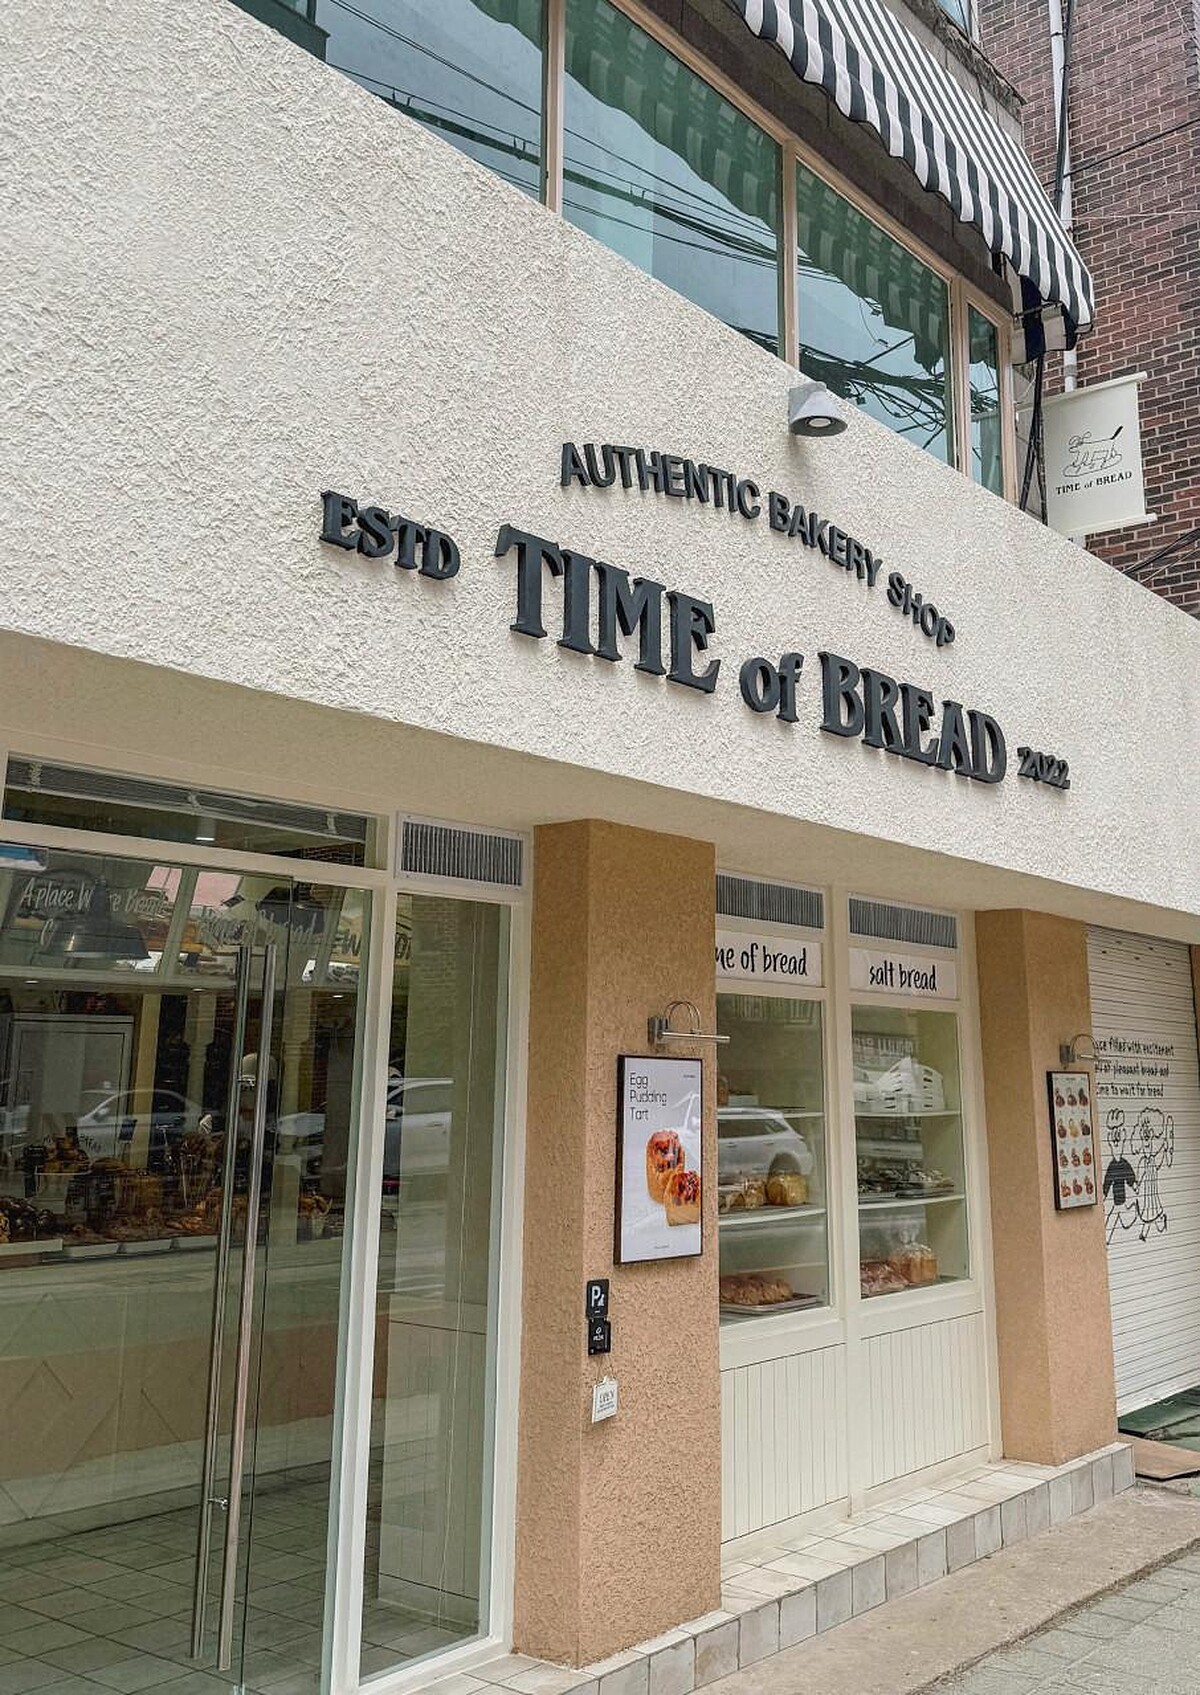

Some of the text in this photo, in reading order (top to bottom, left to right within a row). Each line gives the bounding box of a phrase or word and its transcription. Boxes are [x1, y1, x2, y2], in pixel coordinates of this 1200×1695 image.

[1056, 471, 1132, 495] TIME of BREAD
[561, 442, 955, 647] AUTHENTIC BAKERY SHOP
[319, 489, 1070, 789] ESTD TIME of BREAD 2022
[35, 881, 74, 909] place
[740, 942, 759, 973] of
[762, 945, 808, 976] bread
[869, 959, 938, 992] salt bread
[630, 1072, 648, 1089] Egg
[630, 1089, 667, 1107] Pudding
[630, 1107, 648, 1121] Tart
